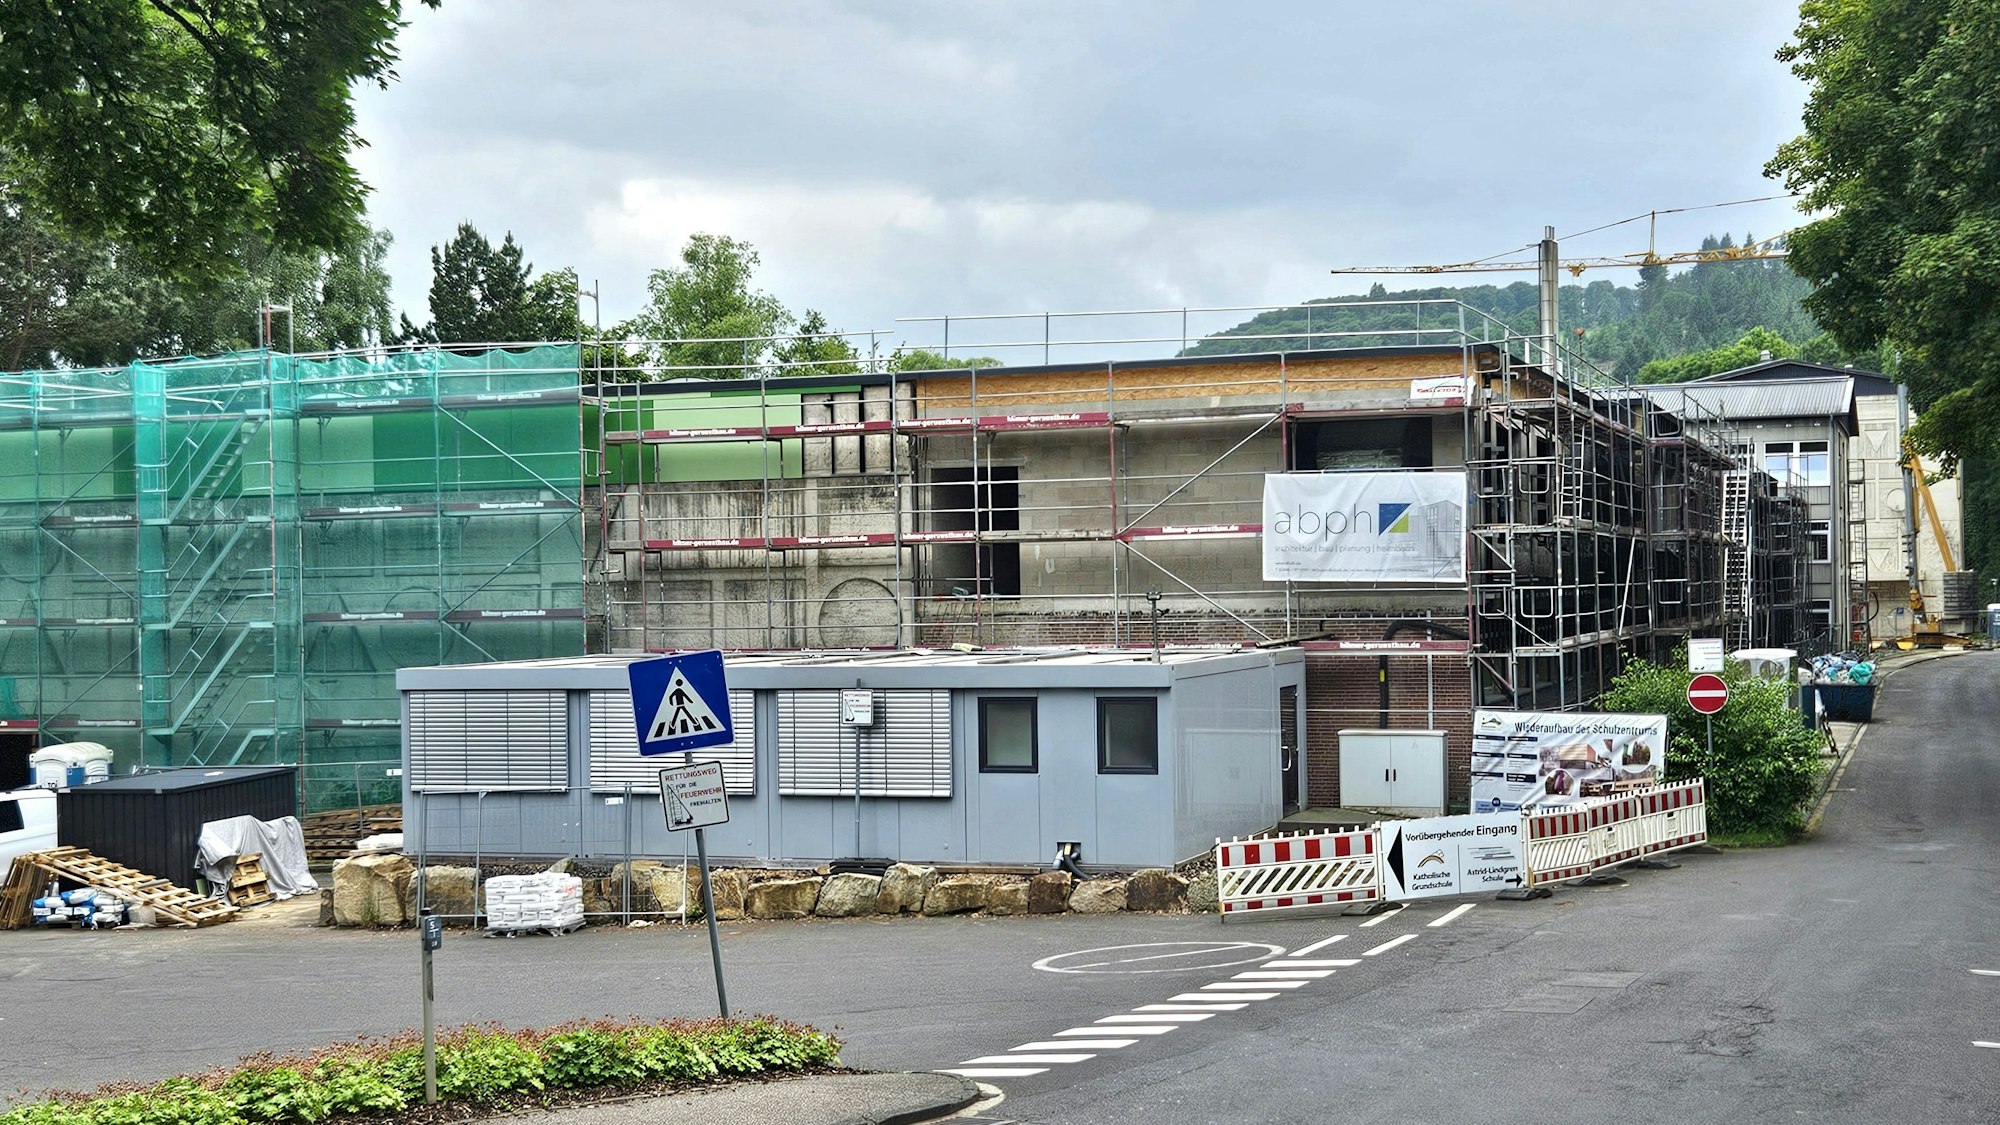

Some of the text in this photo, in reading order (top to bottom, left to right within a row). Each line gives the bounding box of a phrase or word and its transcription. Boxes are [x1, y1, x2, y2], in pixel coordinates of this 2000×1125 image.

[1274, 503, 1372, 541] abph
[1514, 722, 1658, 736] Wiederaufbau des Schulzentrums
[665, 768, 717, 781] RETTUNGSWEG
[681, 787, 722, 798] FEUERWEHR
[690, 798, 721, 806] FREIHALTEN
[1405, 825, 1517, 842] Vorübergehender Eingang
[1413, 871, 1451, 880] Katholische
[1482, 875, 1504, 883] Schule
[1412, 880, 1453, 891] Grundschule
